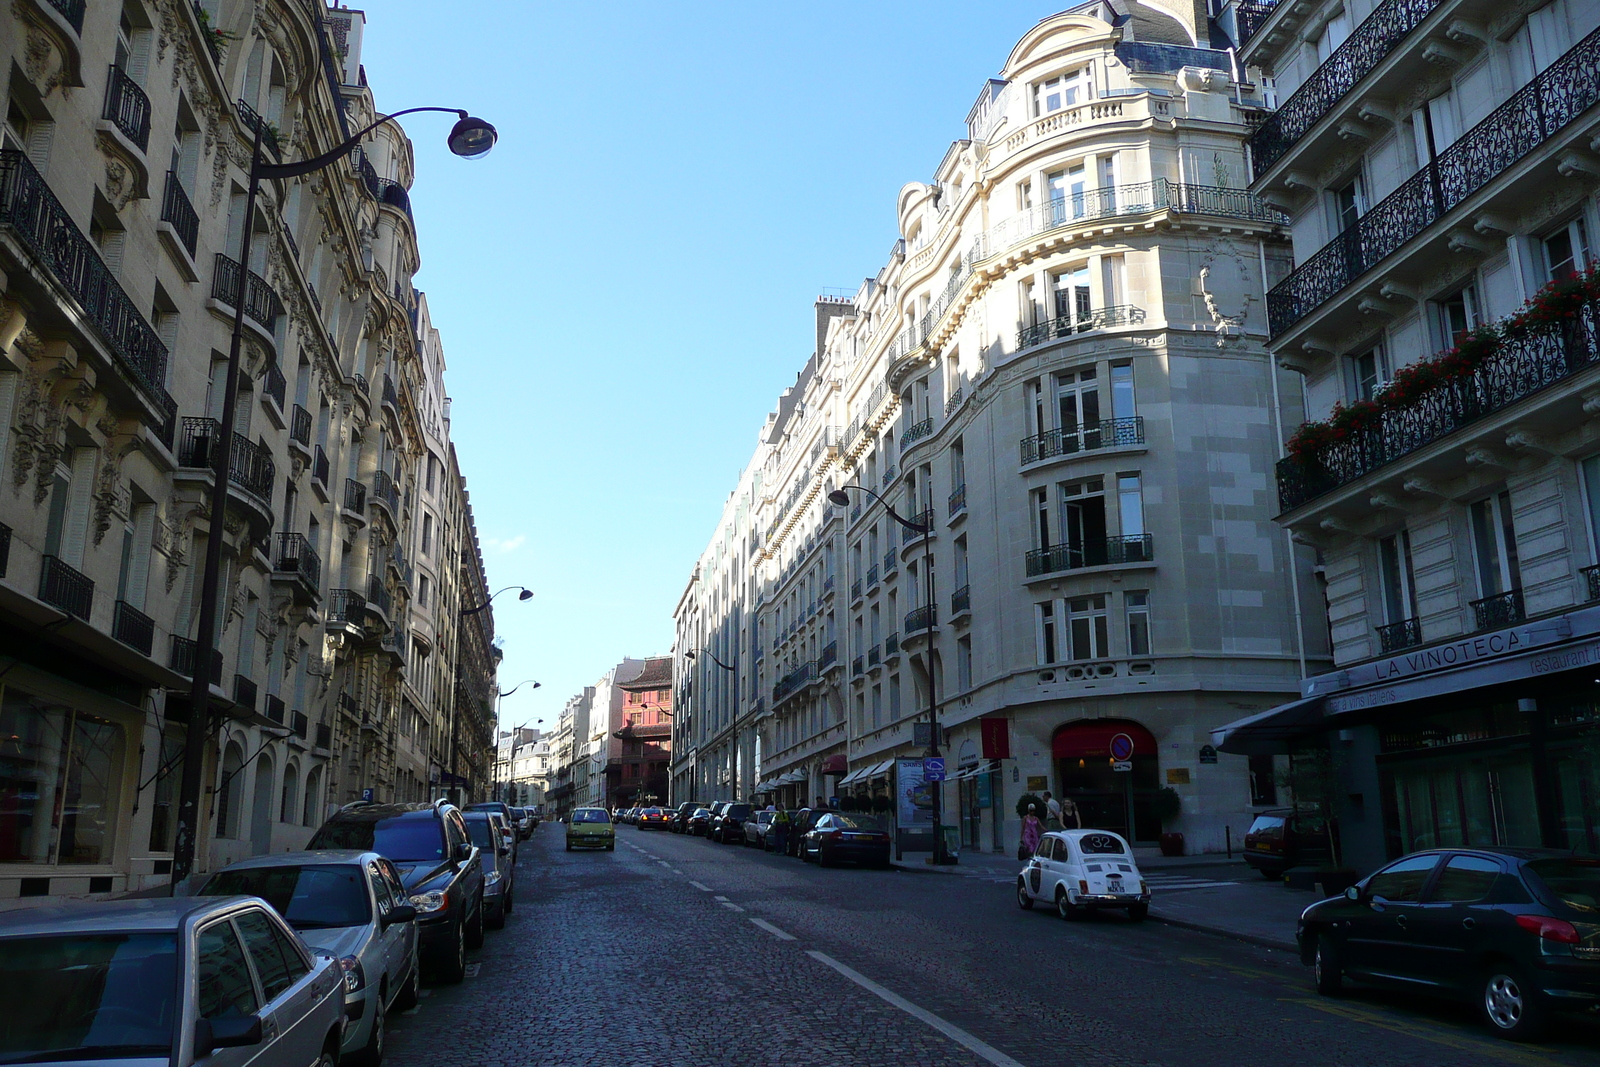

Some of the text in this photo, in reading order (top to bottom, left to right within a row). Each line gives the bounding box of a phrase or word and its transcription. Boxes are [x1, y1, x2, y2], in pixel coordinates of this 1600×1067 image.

[1375, 631, 1523, 680] LA VINOTECA
[1530, 647, 1590, 674] restaurant
[1349, 694, 1365, 709] vins
[1367, 690, 1397, 707] italiens
[1091, 836, 1113, 848] 32
